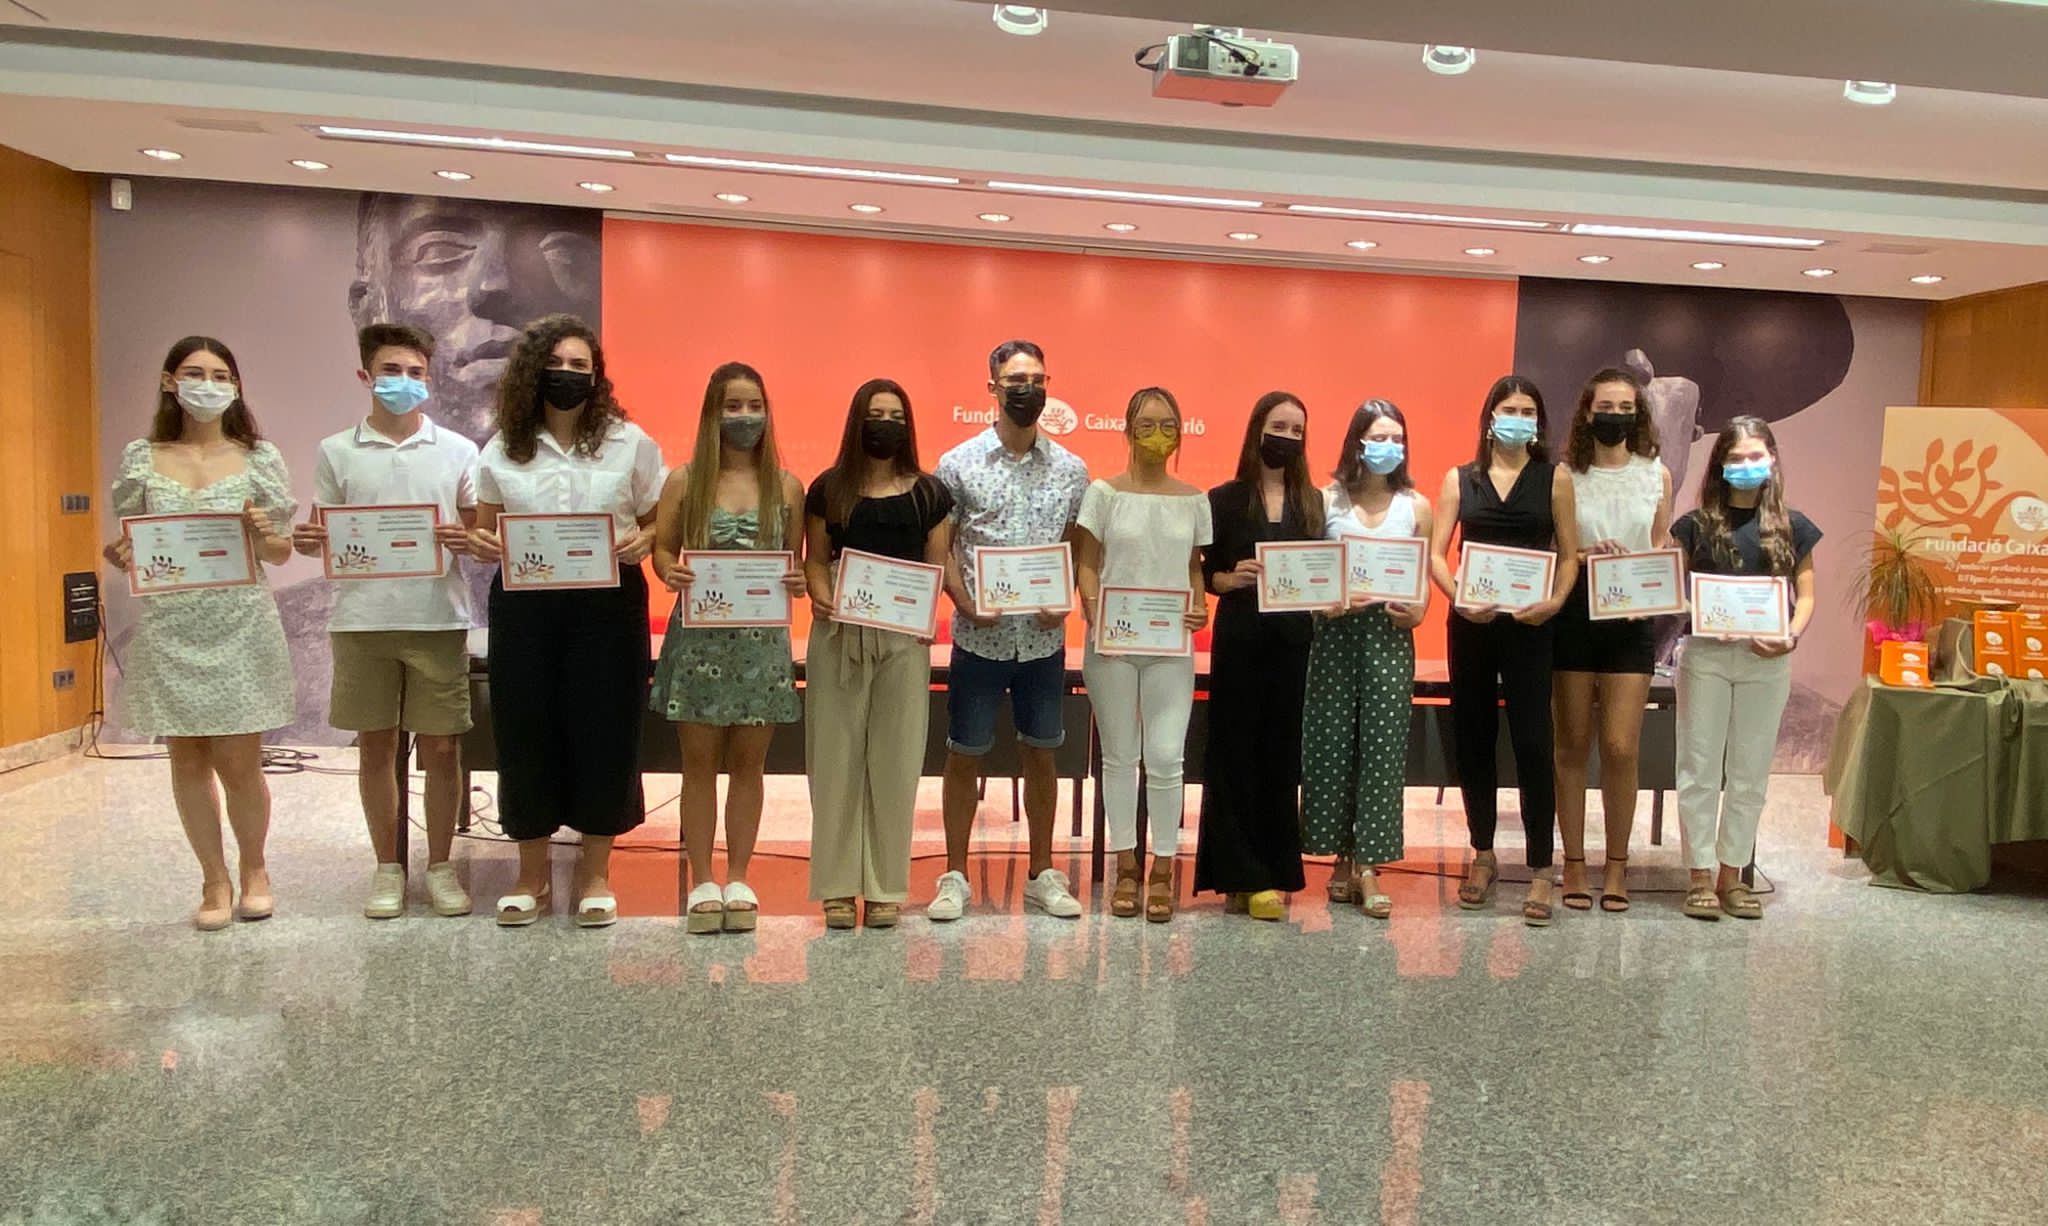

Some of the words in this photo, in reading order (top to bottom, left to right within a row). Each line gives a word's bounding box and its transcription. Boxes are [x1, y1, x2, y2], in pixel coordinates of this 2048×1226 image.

[953, 405, 999, 424] Fund
[1084, 413, 1127, 432] Caixa
[1925, 536, 2001, 553] Fundació
[2005, 540, 2048, 556] Caixa
